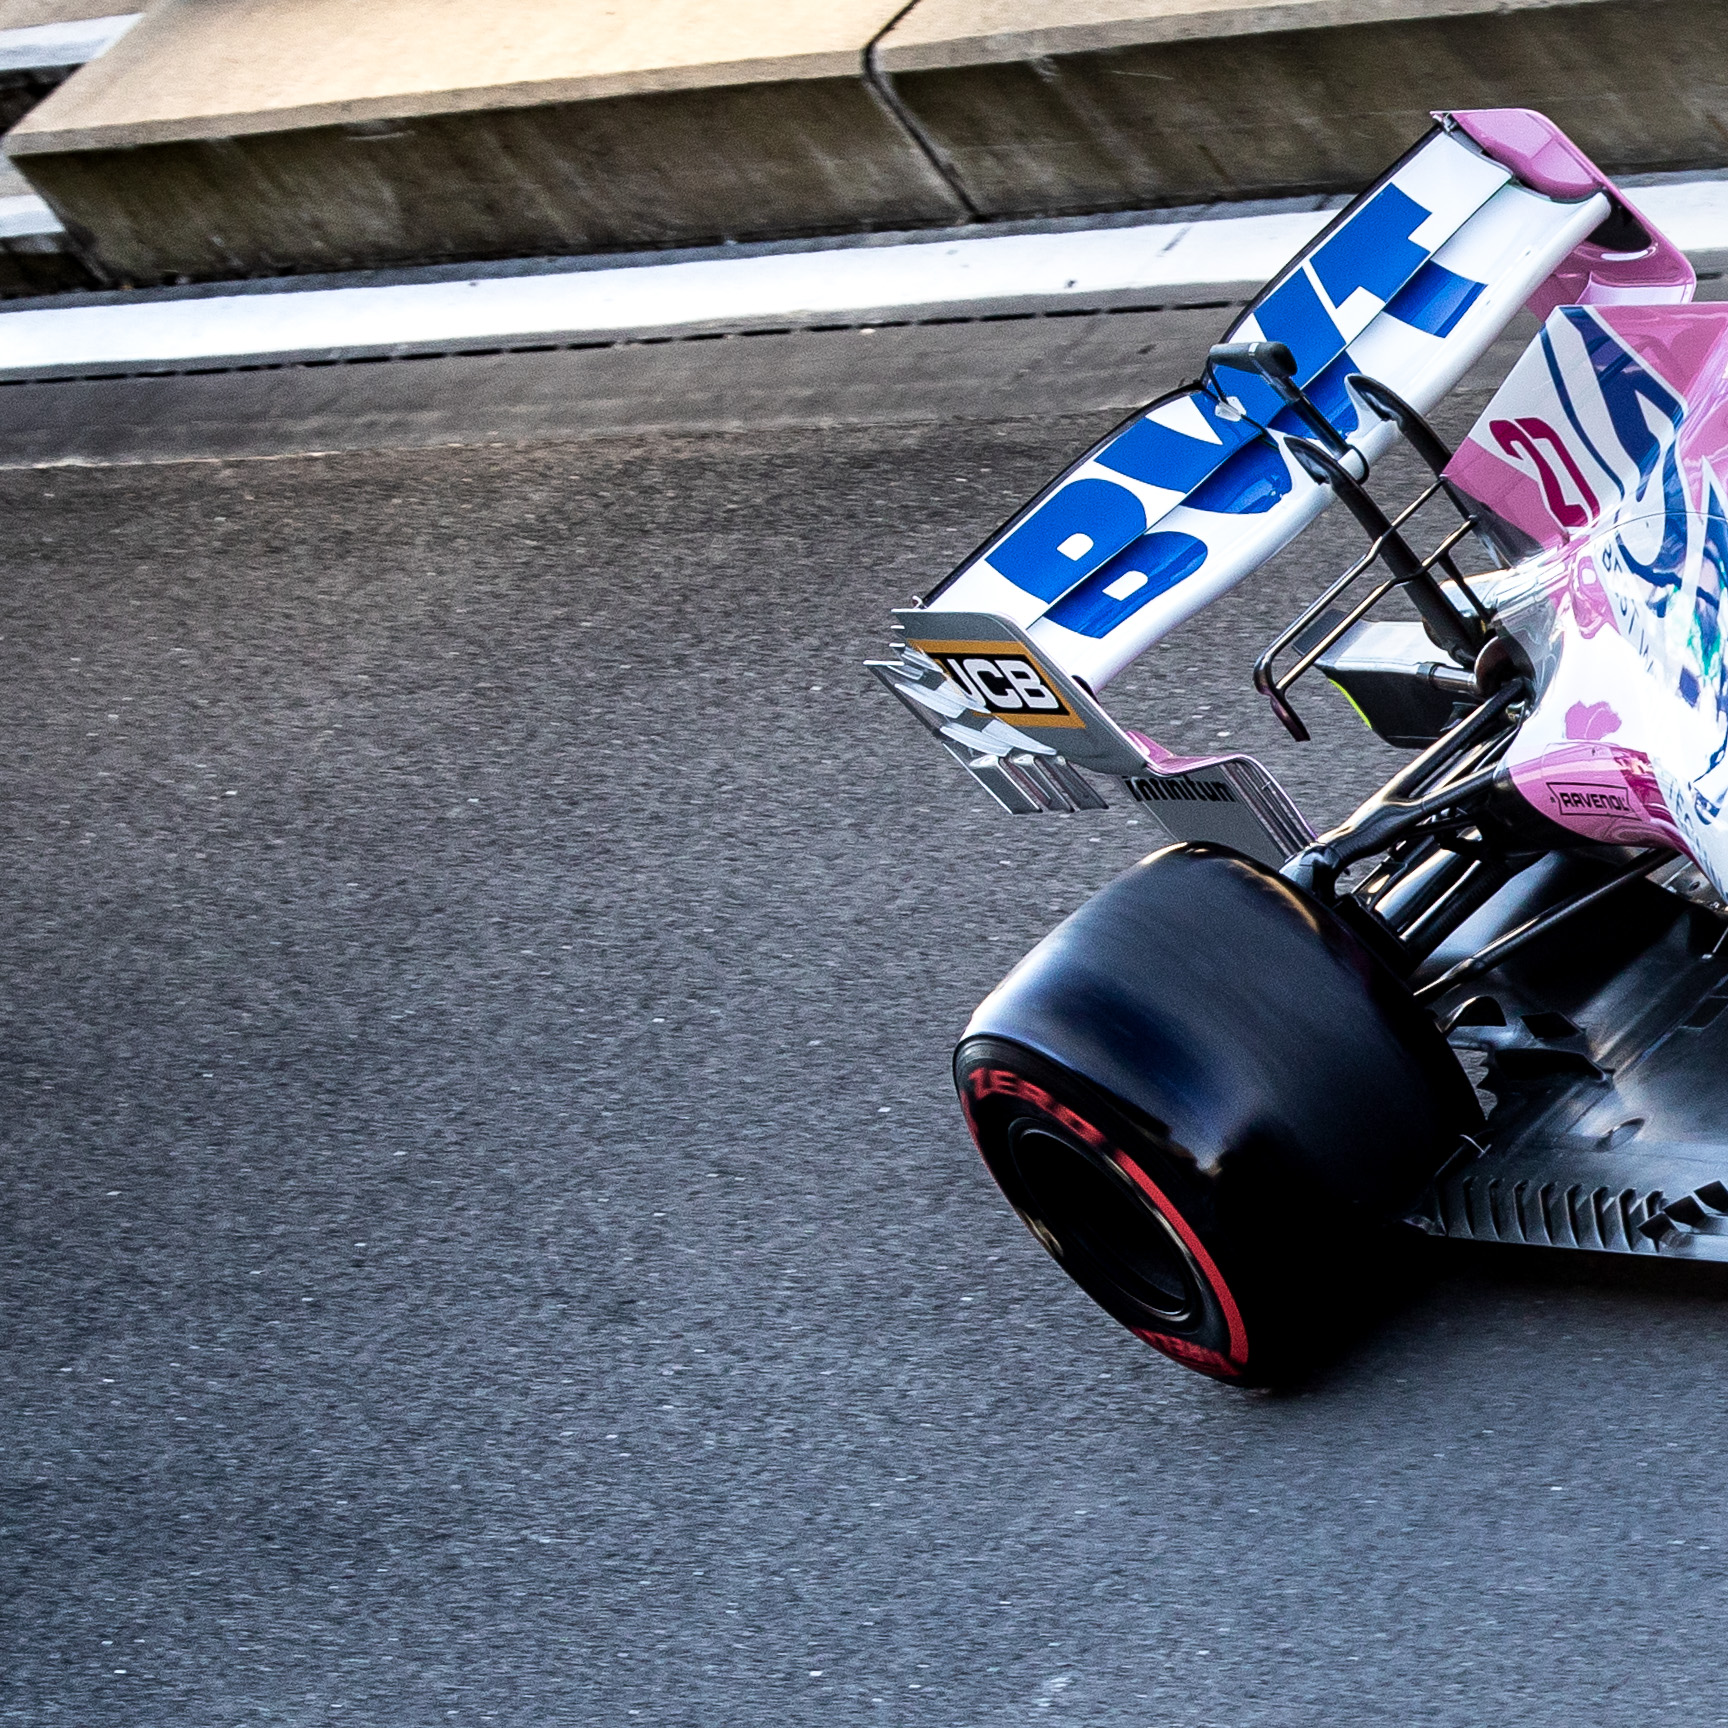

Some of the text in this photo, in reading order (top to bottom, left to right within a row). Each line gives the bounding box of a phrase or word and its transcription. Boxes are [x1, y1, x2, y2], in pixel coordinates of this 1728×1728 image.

[985, 182, 1488, 639] BWT
[1489, 417, 1600, 529] 27
[946, 658, 1060, 710] JCB
[1560, 792, 1630, 811] RAVENOL
